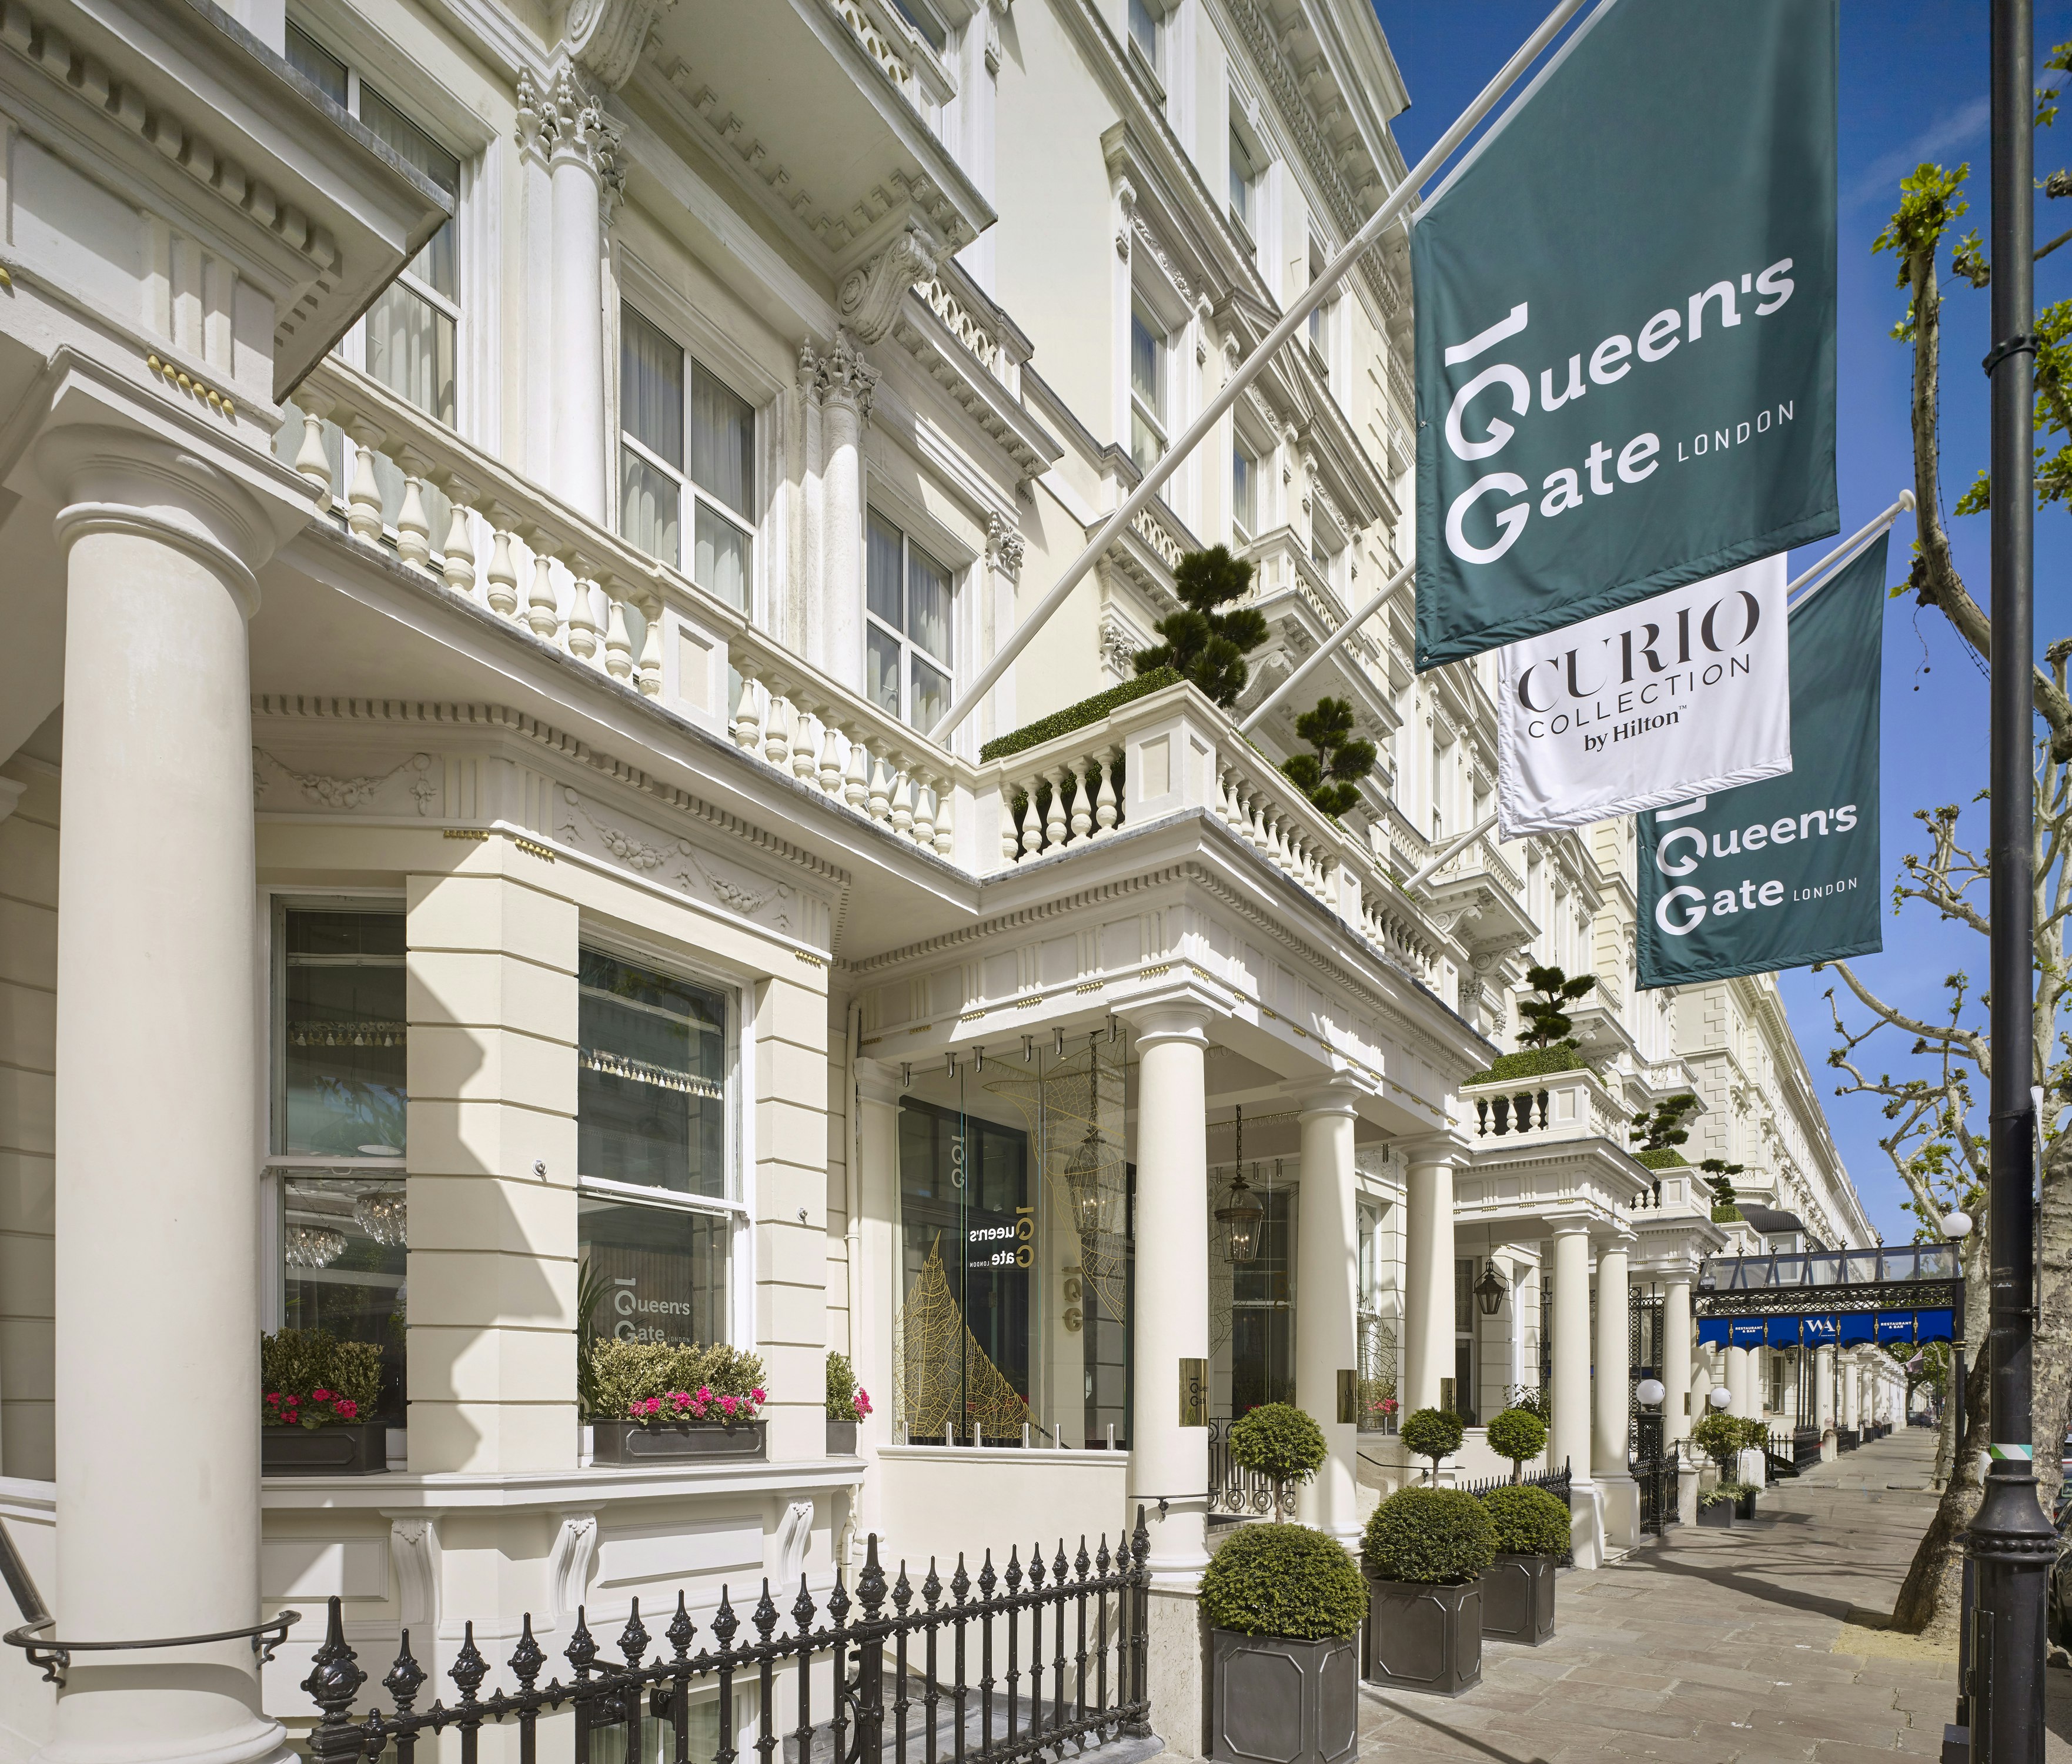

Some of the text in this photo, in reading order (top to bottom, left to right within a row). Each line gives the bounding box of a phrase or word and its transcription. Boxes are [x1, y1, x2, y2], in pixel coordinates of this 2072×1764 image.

[1445, 258, 1794, 462] Queen's
[1445, 400, 1794, 564] Gate LONDON
[1519, 590, 1760, 713] CURIO
[1528, 653, 1750, 739] COLLECTION
[1583, 731, 1609, 753] by
[1656, 804, 1857, 877] Queen's
[1655, 877, 1857, 936] Gate LONDON
[614, 1289, 690, 1316] Queen's
[614, 1320, 665, 1344] Gate
